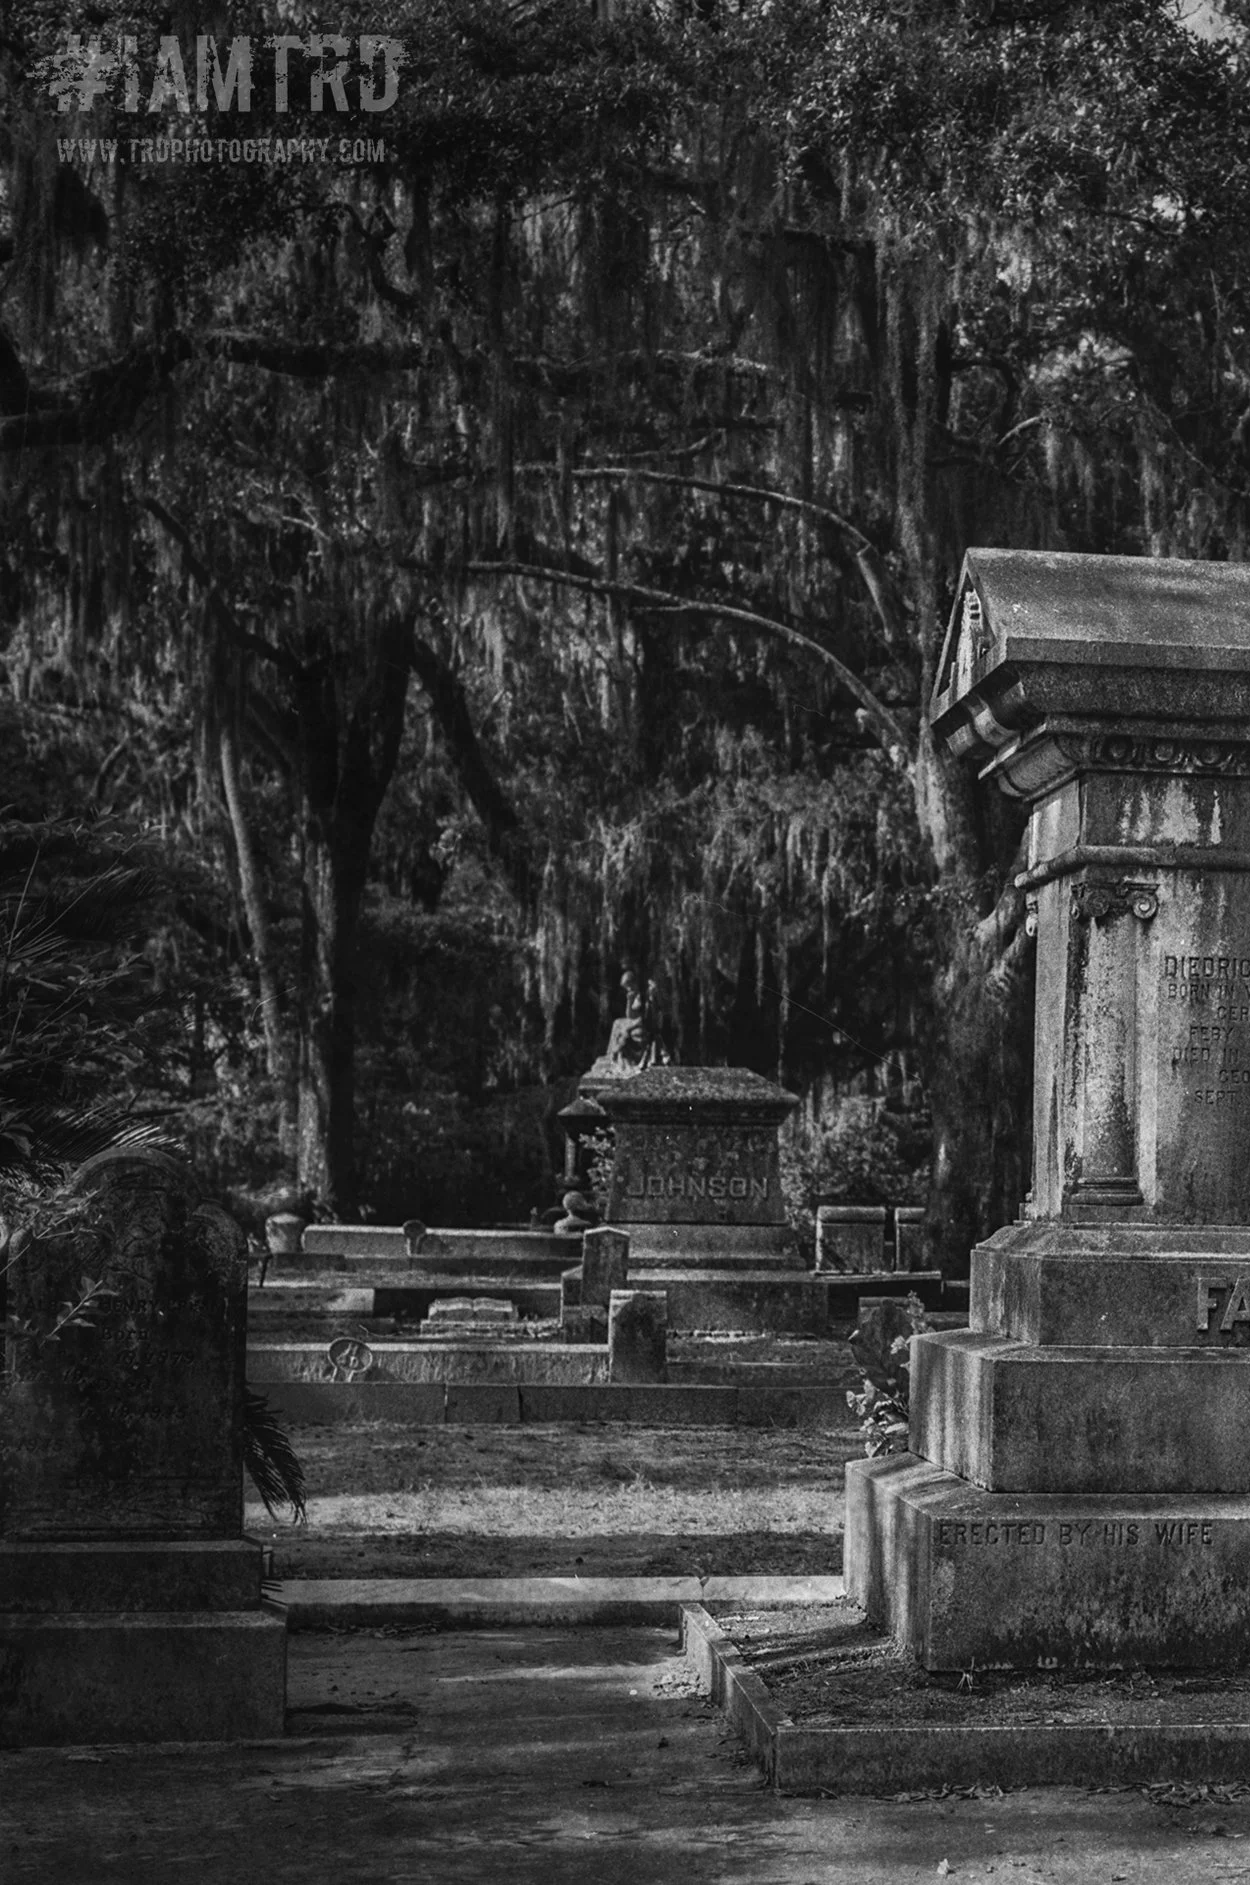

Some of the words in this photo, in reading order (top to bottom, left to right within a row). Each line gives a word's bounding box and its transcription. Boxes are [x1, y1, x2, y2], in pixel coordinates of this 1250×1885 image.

[1168, 983, 1210, 1001] BORN
[1217, 985, 1235, 1001] IN
[1172, 1047, 1211, 1063] DIED
[626, 1175, 768, 1199] JOHNSON
[936, 1522, 1047, 1548] ERECTED
[1058, 1522, 1092, 1548] BY
[1103, 1522, 1141, 1548] HIS
[1153, 1523, 1215, 1548] WIFE
